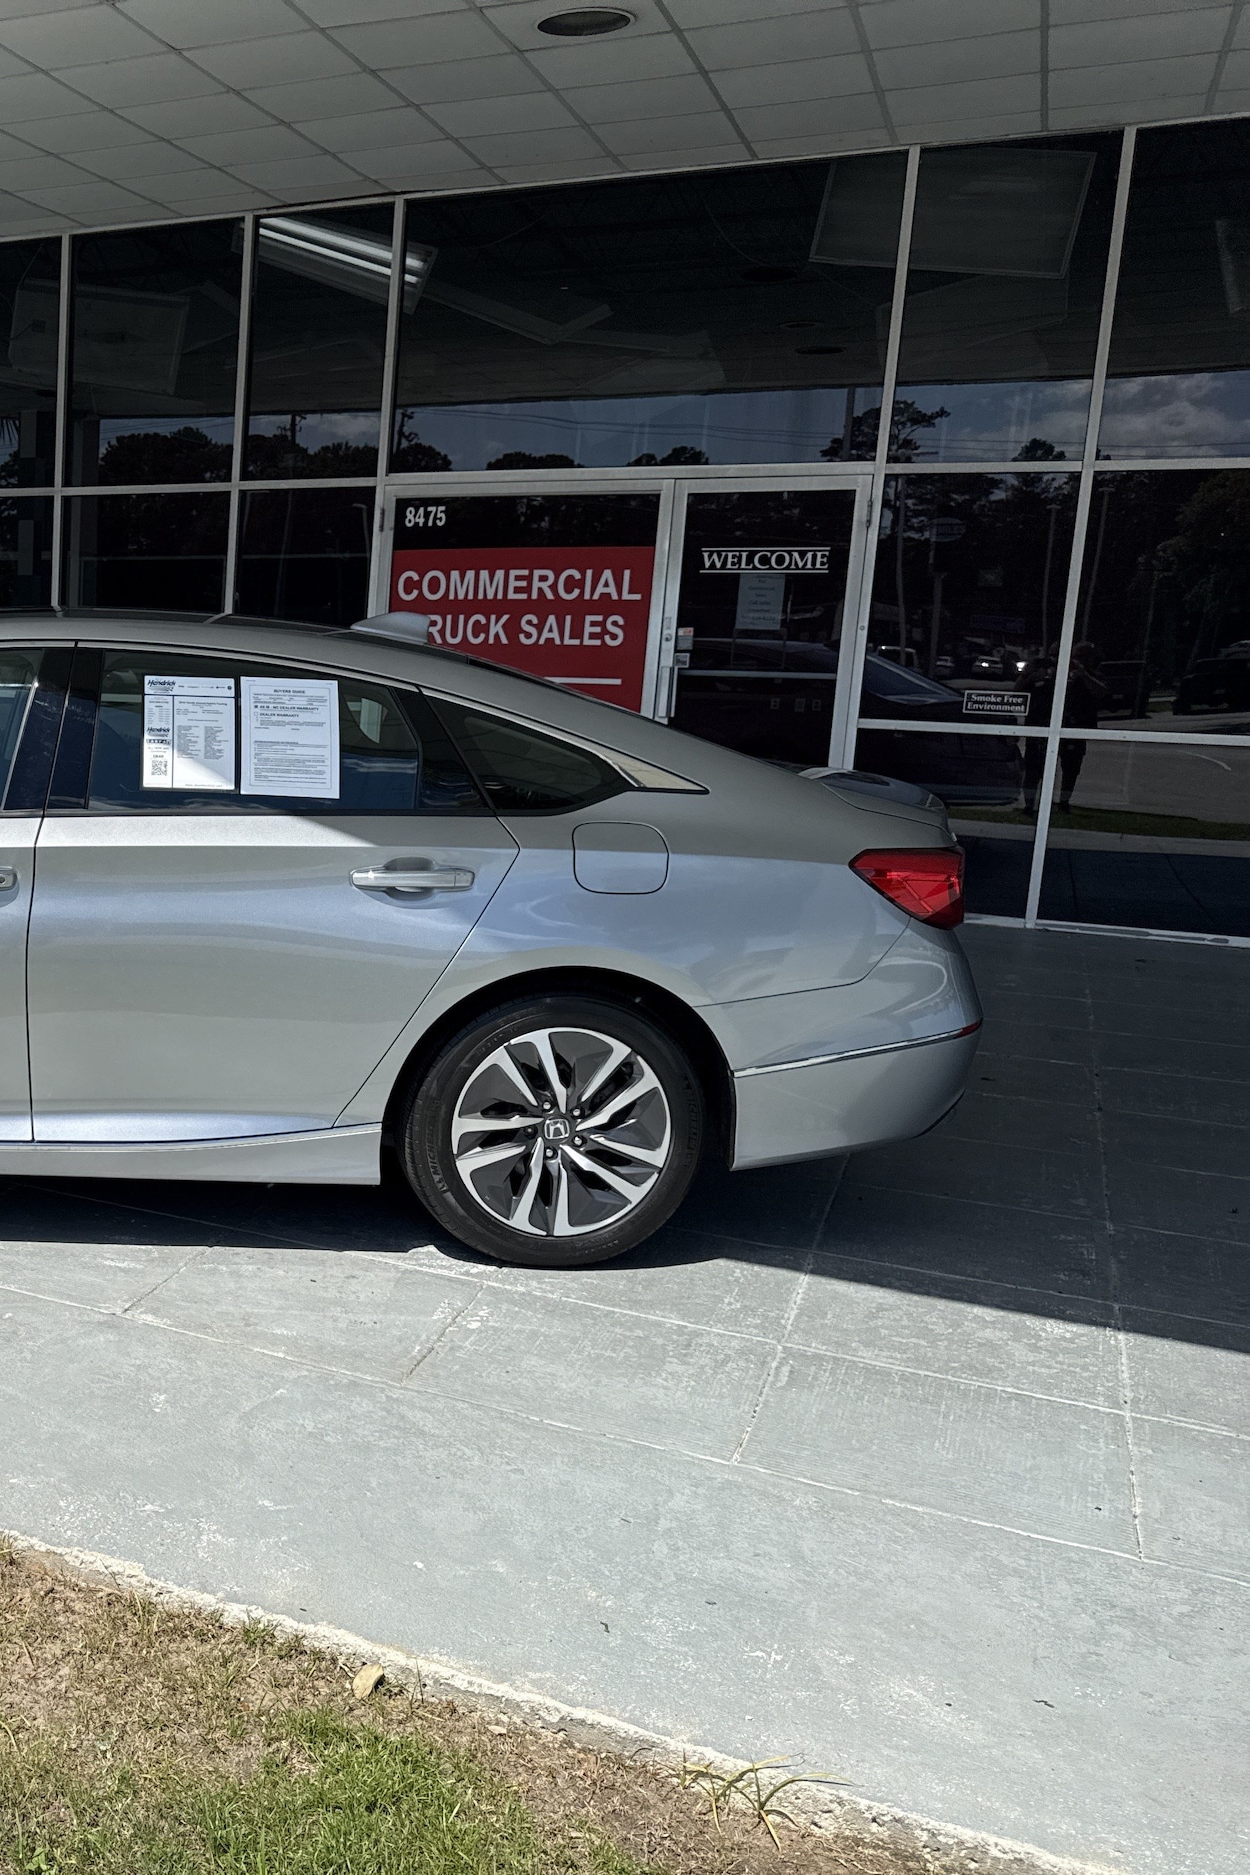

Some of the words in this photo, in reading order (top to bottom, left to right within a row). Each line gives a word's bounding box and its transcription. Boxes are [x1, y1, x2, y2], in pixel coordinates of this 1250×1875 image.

[405, 506, 447, 528] 8475
[702, 551, 830, 570] WELCOME
[397, 568, 642, 601] COMMERCIAL
[427, 614, 510, 645] RUCK
[518, 614, 625, 647] SALES
[967, 702, 1025, 712] Environment
[971, 694, 1002, 703] Smoke
[1003, 695, 1023, 703] Free
